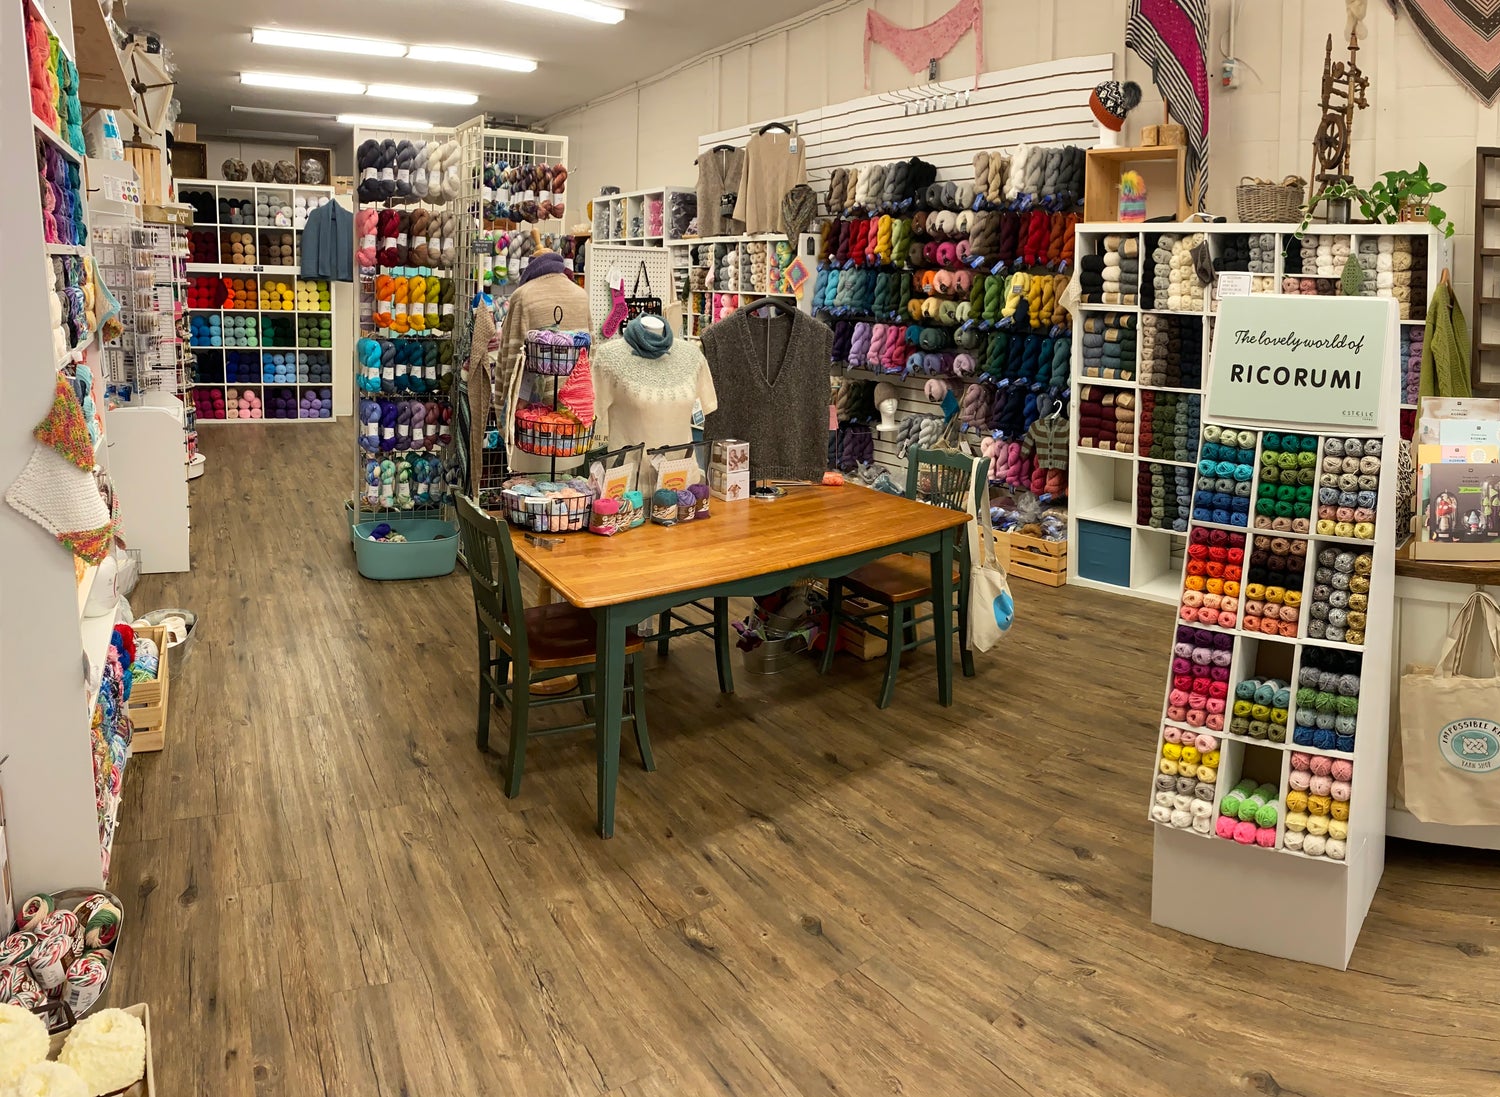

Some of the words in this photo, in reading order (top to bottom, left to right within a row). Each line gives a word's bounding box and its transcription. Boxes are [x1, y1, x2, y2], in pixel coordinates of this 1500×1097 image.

[1235, 330, 1257, 345] The
[1258, 330, 1303, 352] lovely
[1303, 334, 1348, 349] world
[1348, 335, 1365, 354] of
[1230, 363, 1362, 390] RICORUMI
[1442, 720, 1488, 744] IMPOSSIBLE
[1461, 760, 1476, 768] YARN
